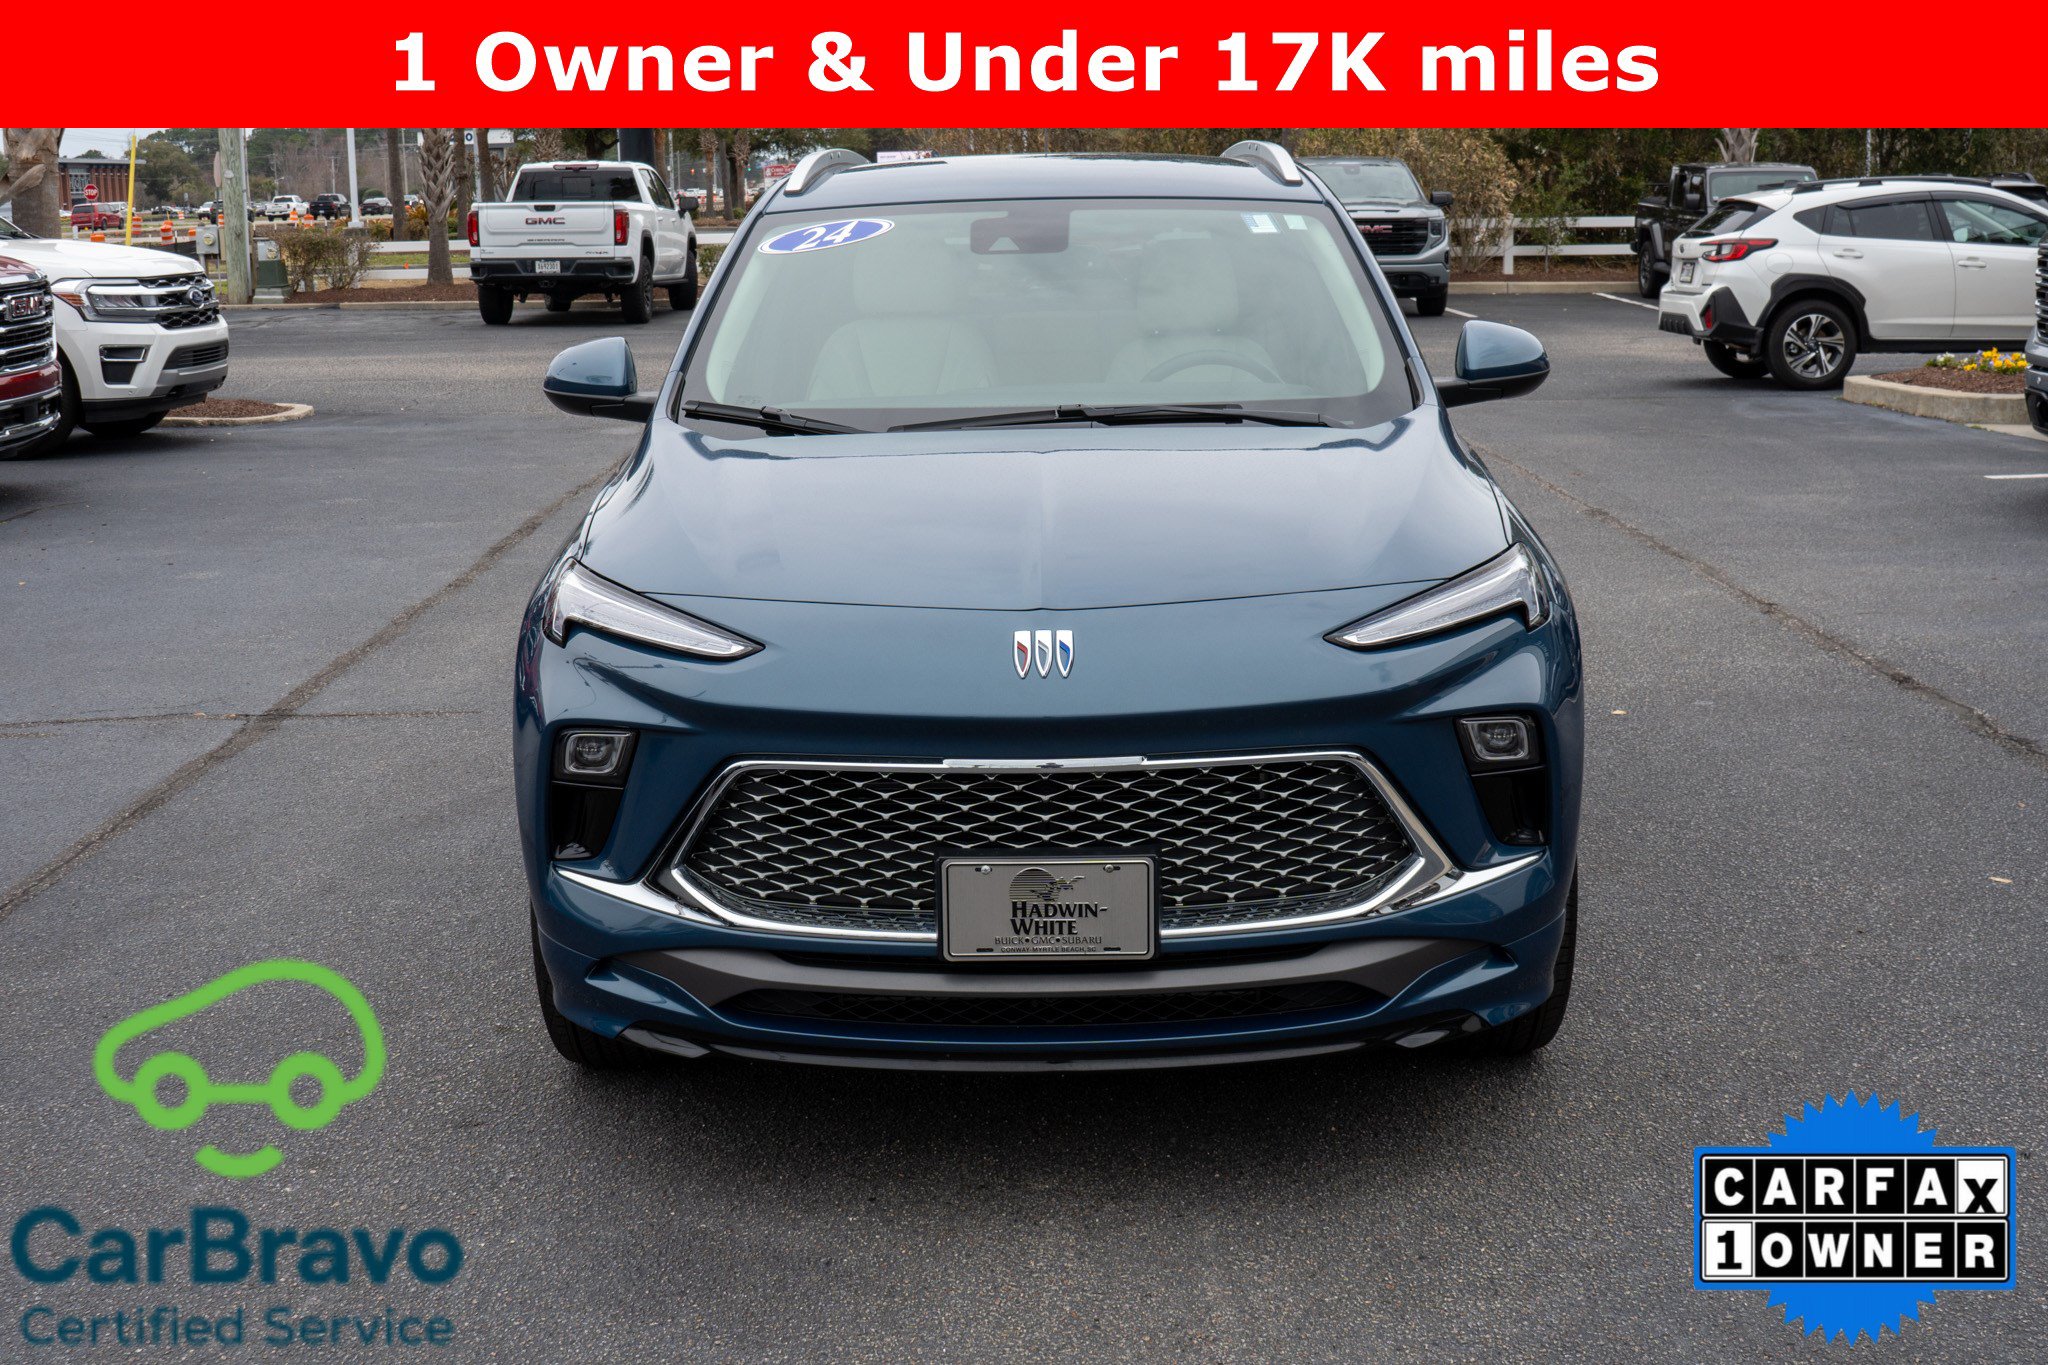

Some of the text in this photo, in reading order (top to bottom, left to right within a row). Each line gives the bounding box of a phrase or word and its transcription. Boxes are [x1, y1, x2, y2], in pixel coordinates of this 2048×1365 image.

[525, 217, 565, 225] GMC
[792, 220, 858, 251] 24
[1010, 919, 1078, 935] WHITE
